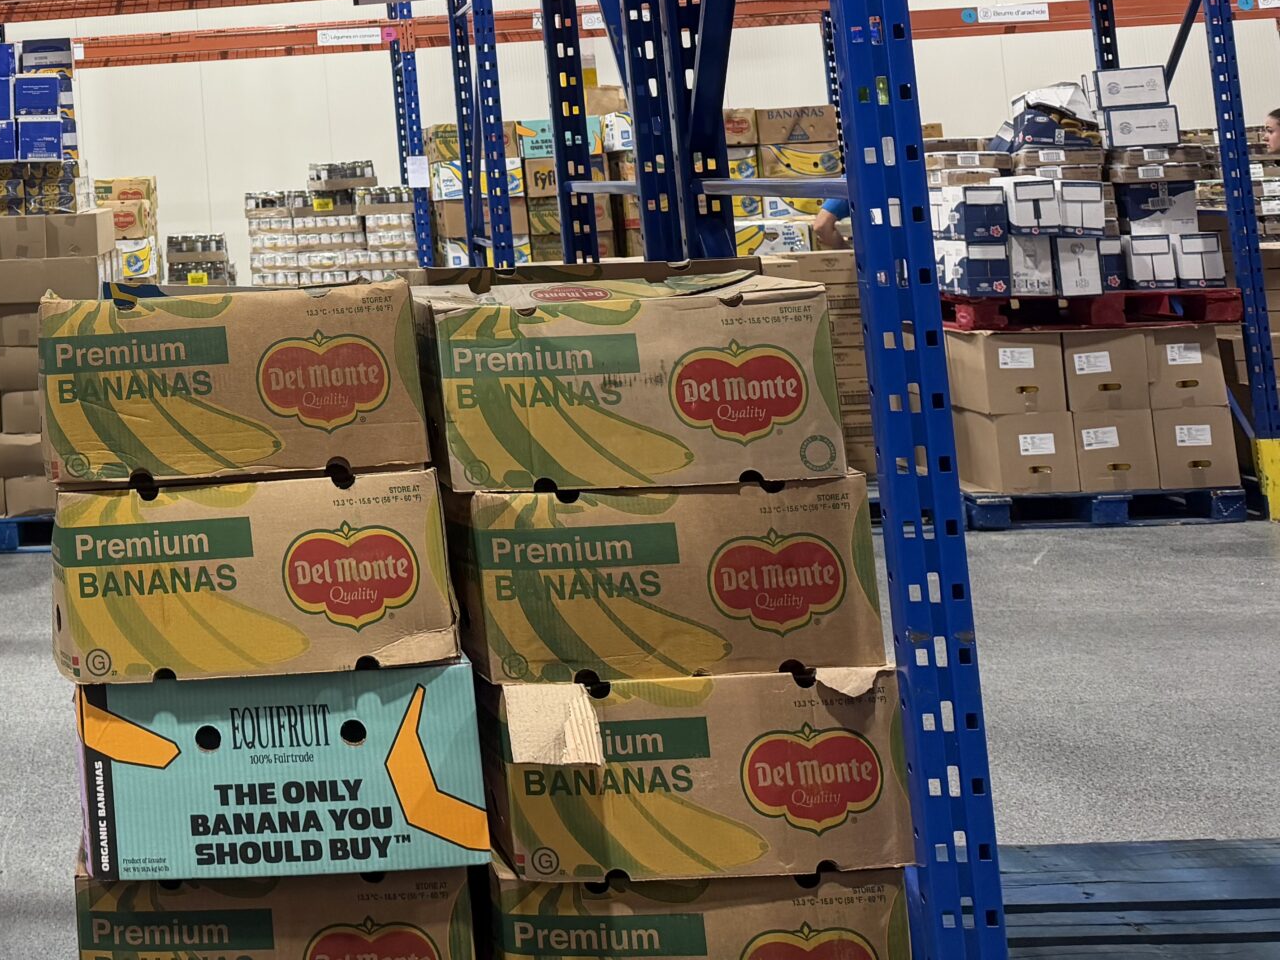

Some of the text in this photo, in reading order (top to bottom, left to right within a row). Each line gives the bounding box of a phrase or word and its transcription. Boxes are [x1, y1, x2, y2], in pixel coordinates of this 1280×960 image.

[767, 107, 825, 120] BANANAS
[362, 296, 383, 304] STORE
[56, 339, 186, 368] Premium
[453, 344, 594, 373] Premium
[58, 370, 212, 404] BANANAS
[268, 361, 380, 390] Del Monte
[681, 374, 798, 404] Del Monte
[302, 392, 349, 409] Quality
[456, 380, 622, 410] BNANAS
[716, 404, 767, 422] Quality
[389, 484, 420, 494] STORE AT
[816, 492, 849, 502] STORE AT
[75, 528, 210, 561] Premium
[492, 535, 633, 564] Premium
[78, 563, 238, 599] BANANAS
[294, 554, 409, 586] Del Monte
[720, 562, 836, 591] Del Monte
[329, 584, 378, 604] Quality
[496, 570, 662, 602] BNANAS
[756, 592, 805, 610] Quality
[229, 704, 330, 751] EQUIFRUIT
[249, 752, 314, 766] 100% Fairtrade
[754, 758, 872, 788] Del Monte
[214, 778, 363, 807] THE ONLY
[524, 764, 694, 797] BANANAS
[790, 788, 842, 806] Quality
[94, 760, 110, 873] ORGANIC BANANAS
[190, 806, 393, 838] BANANA YOU
[194, 838, 326, 866] SHOULD
[92, 918, 229, 946] Premium
[514, 920, 661, 950] Premium
